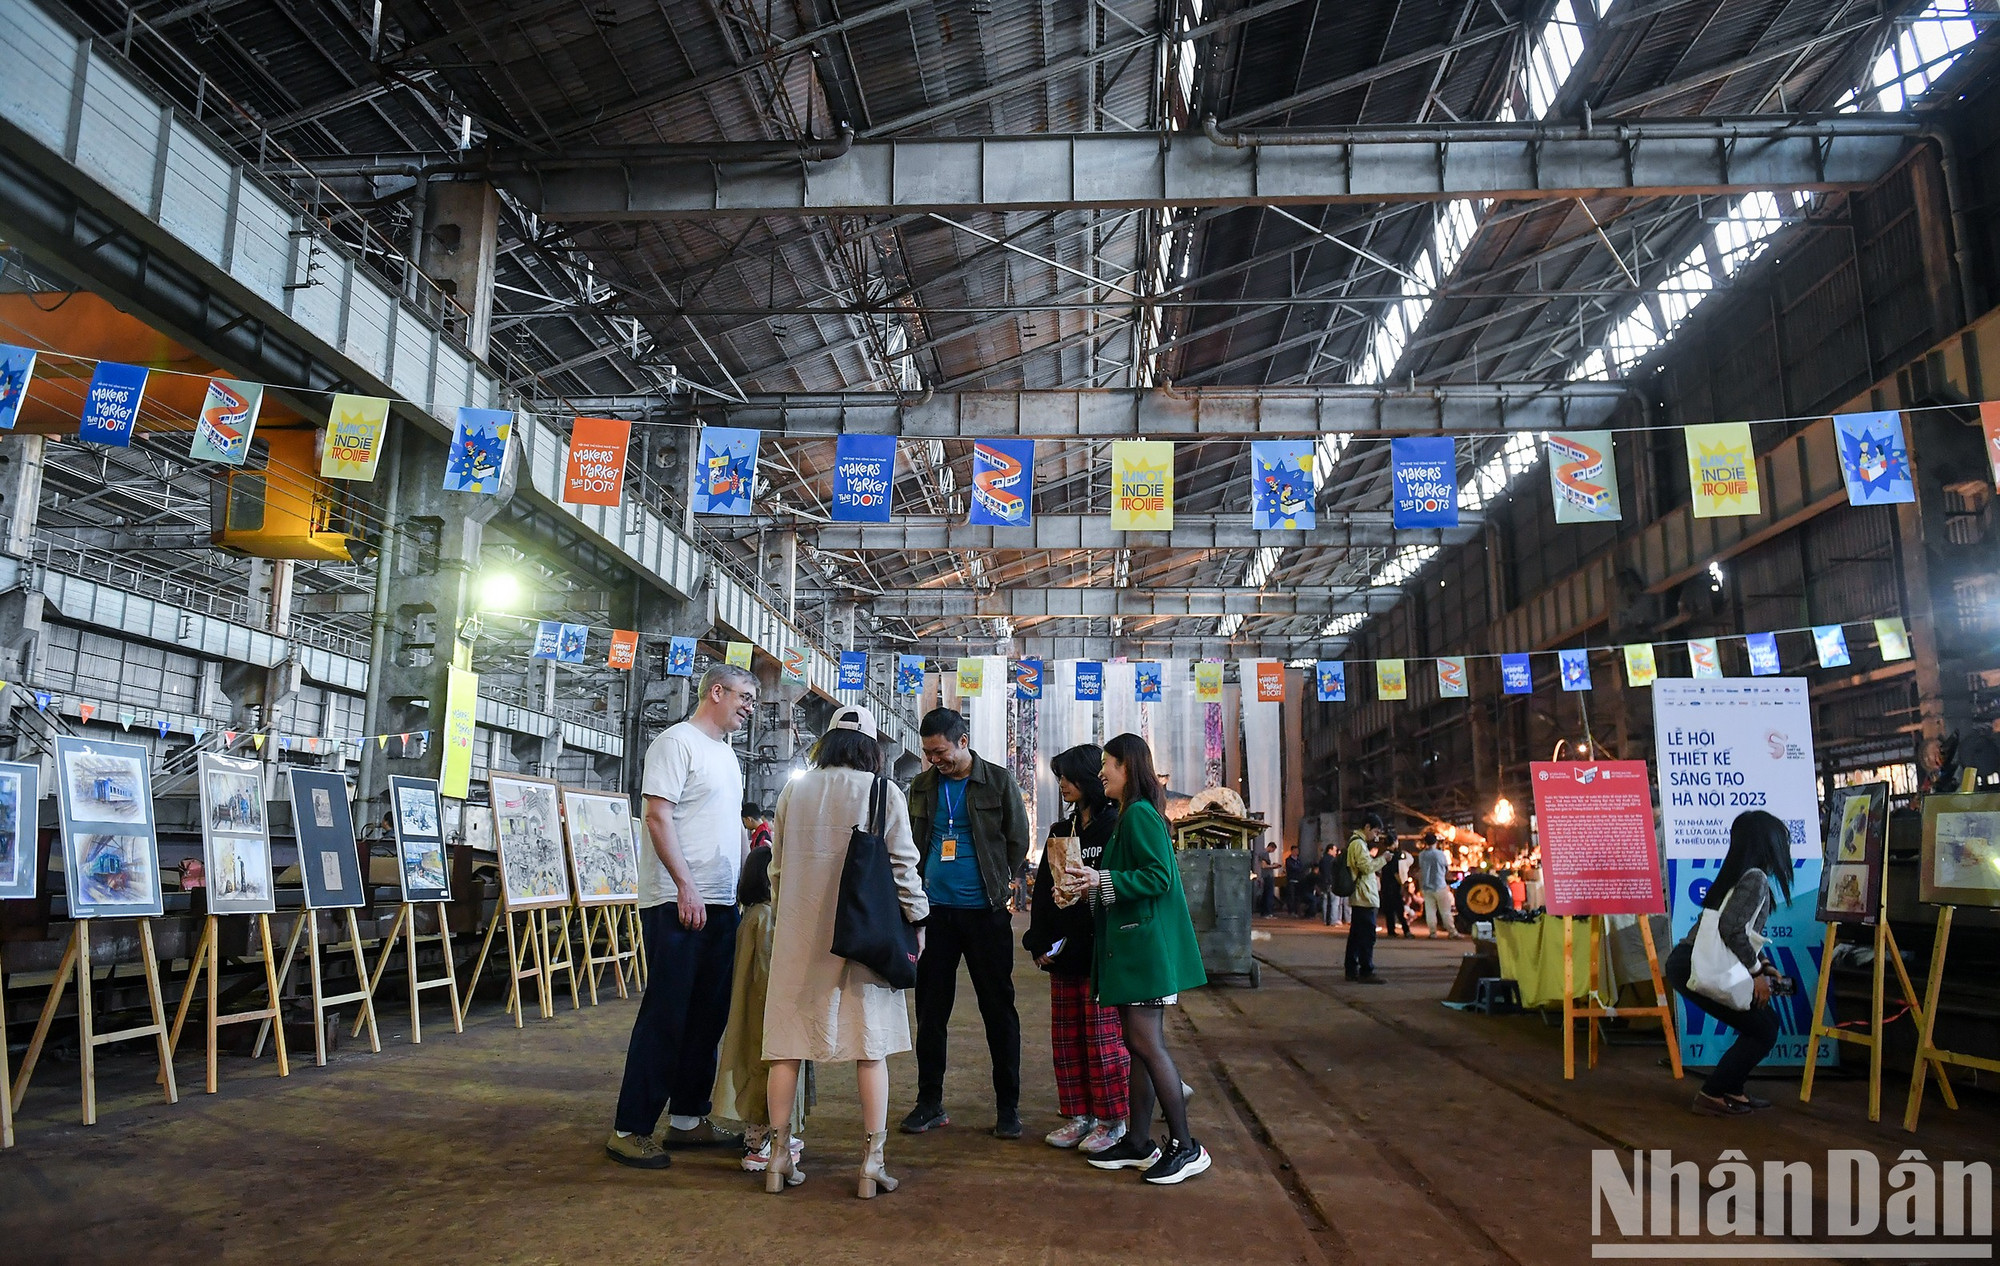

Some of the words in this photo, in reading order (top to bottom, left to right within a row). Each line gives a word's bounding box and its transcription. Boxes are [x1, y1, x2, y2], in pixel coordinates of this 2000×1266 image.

[1667, 727, 1683, 745] LỄ
[1688, 728, 1715, 747] HỘI
[1668, 747, 1708, 765] THIẾT
[1714, 747, 1733, 765] KẾ
[1670, 769, 1711, 786] SÁNG
[1715, 772, 1745, 788] TẠO
[1672, 789, 1693, 806] HÀ
[1698, 789, 1725, 808] NỘI
[1730, 792, 1767, 806] 2023
[1699, 886, 1707, 899] 5
[1771, 926, 1793, 937] 3B2
[1690, 1044, 1704, 1058] 17
